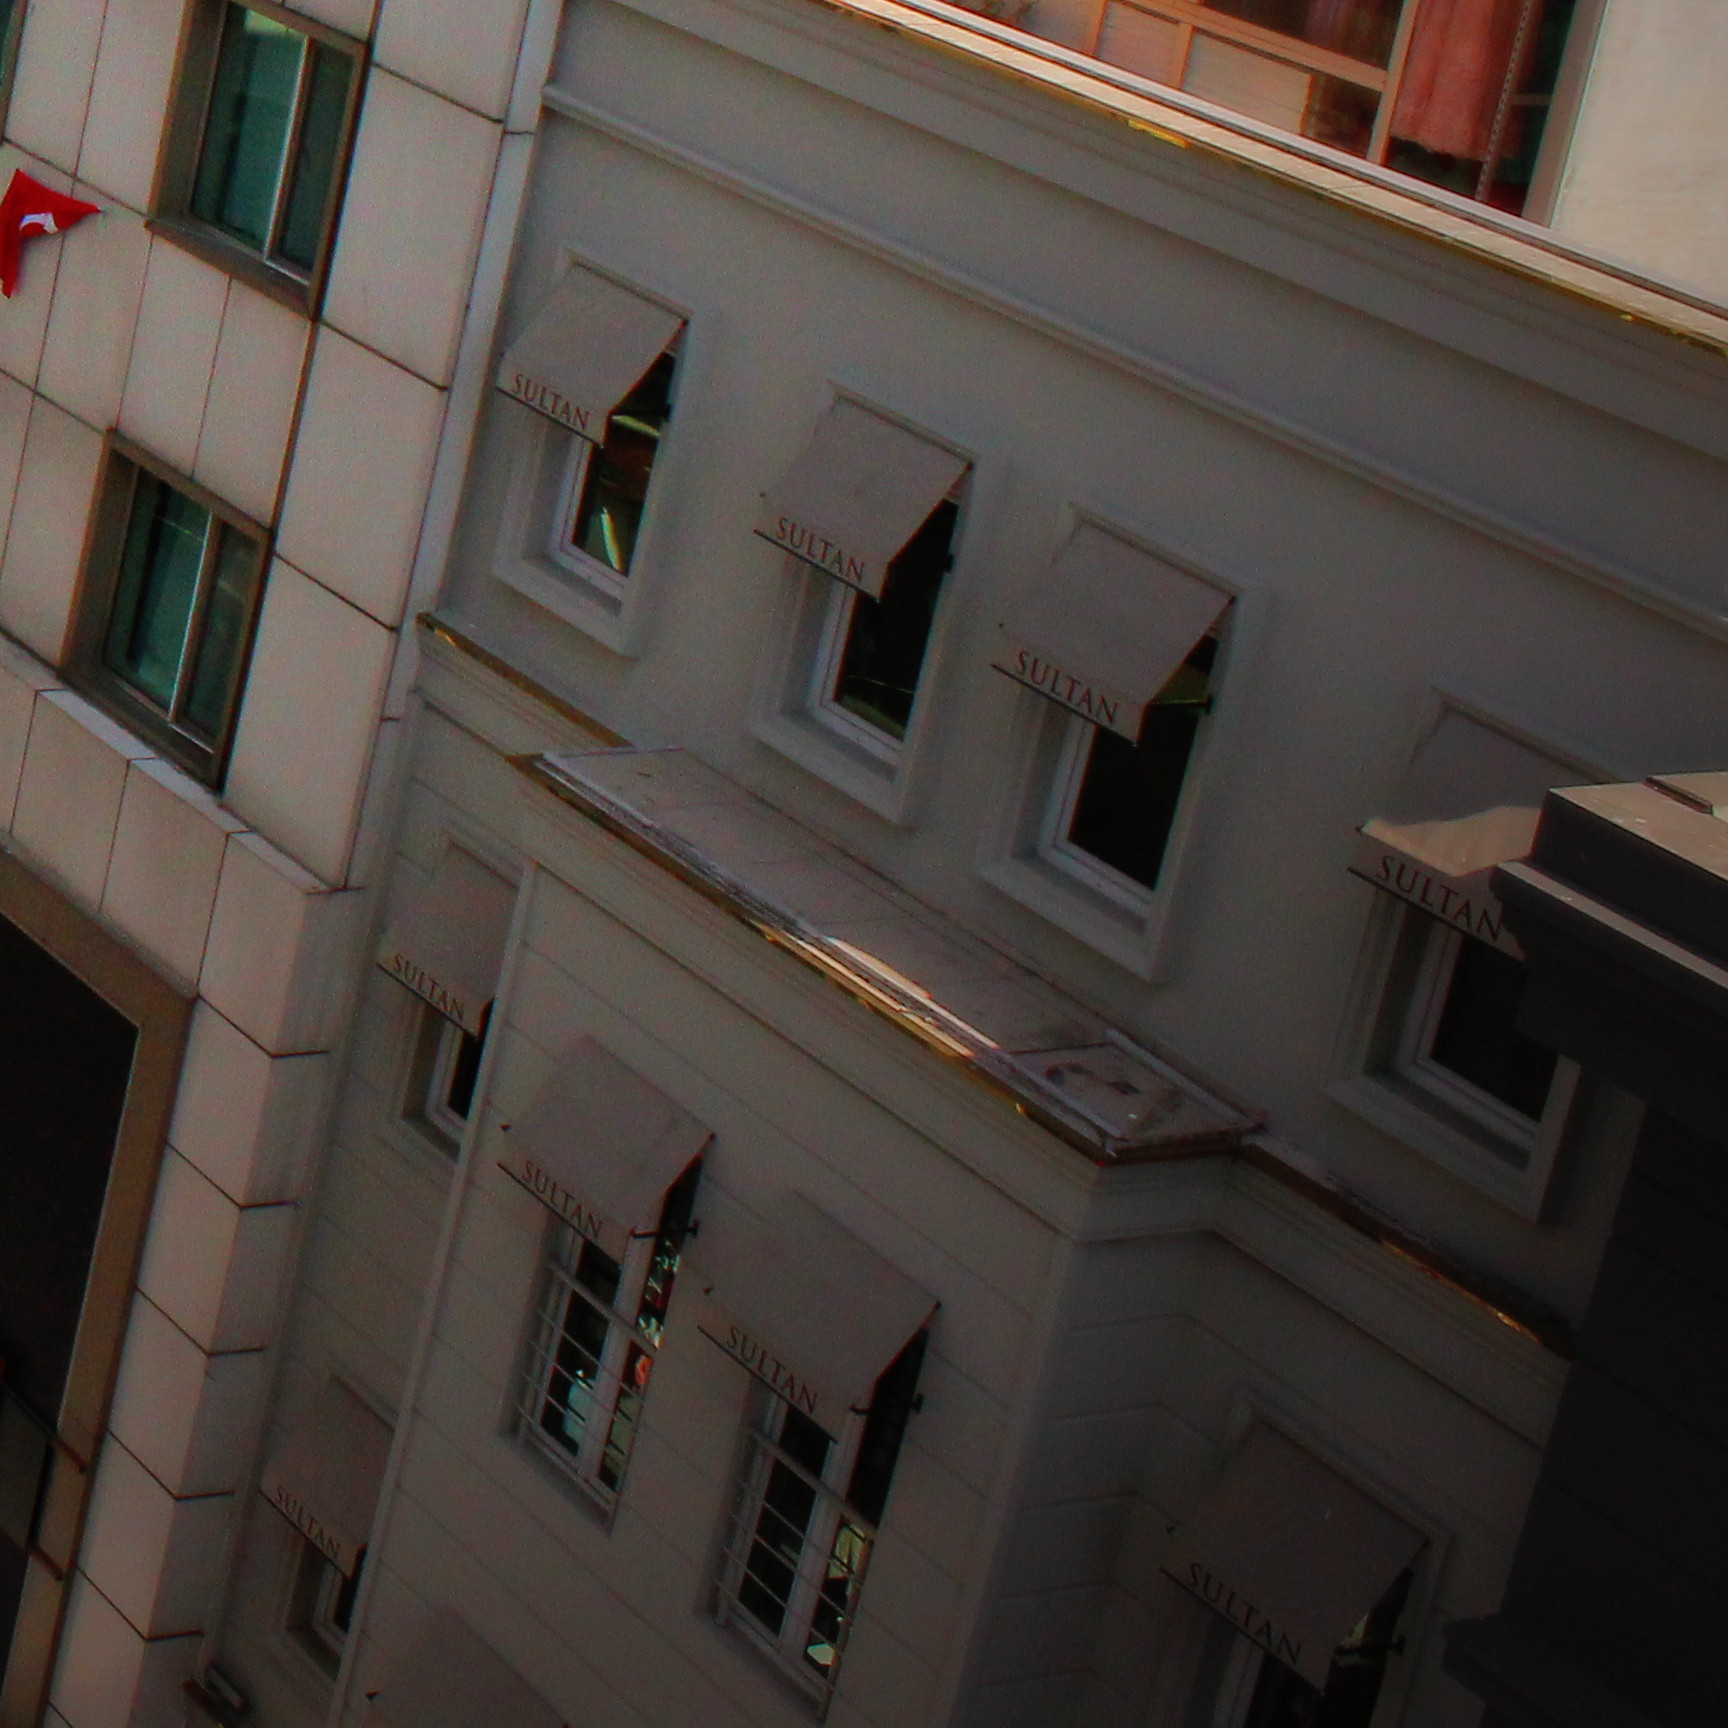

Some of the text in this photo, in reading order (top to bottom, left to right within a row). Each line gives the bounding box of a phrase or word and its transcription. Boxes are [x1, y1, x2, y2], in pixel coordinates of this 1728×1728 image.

[511, 372, 592, 432] SULTAN
[775, 515, 867, 584] SULTAN
[1014, 649, 1120, 725] SULTAN
[1378, 852, 1506, 942] SULTAN
[391, 952, 466, 1024] SULTAN
[520, 1157, 605, 1239] SULTAN
[725, 1323, 820, 1414] SULTAN
[273, 1487, 343, 1562] SULTAN
[1188, 1560, 1304, 1668] SULTAN
